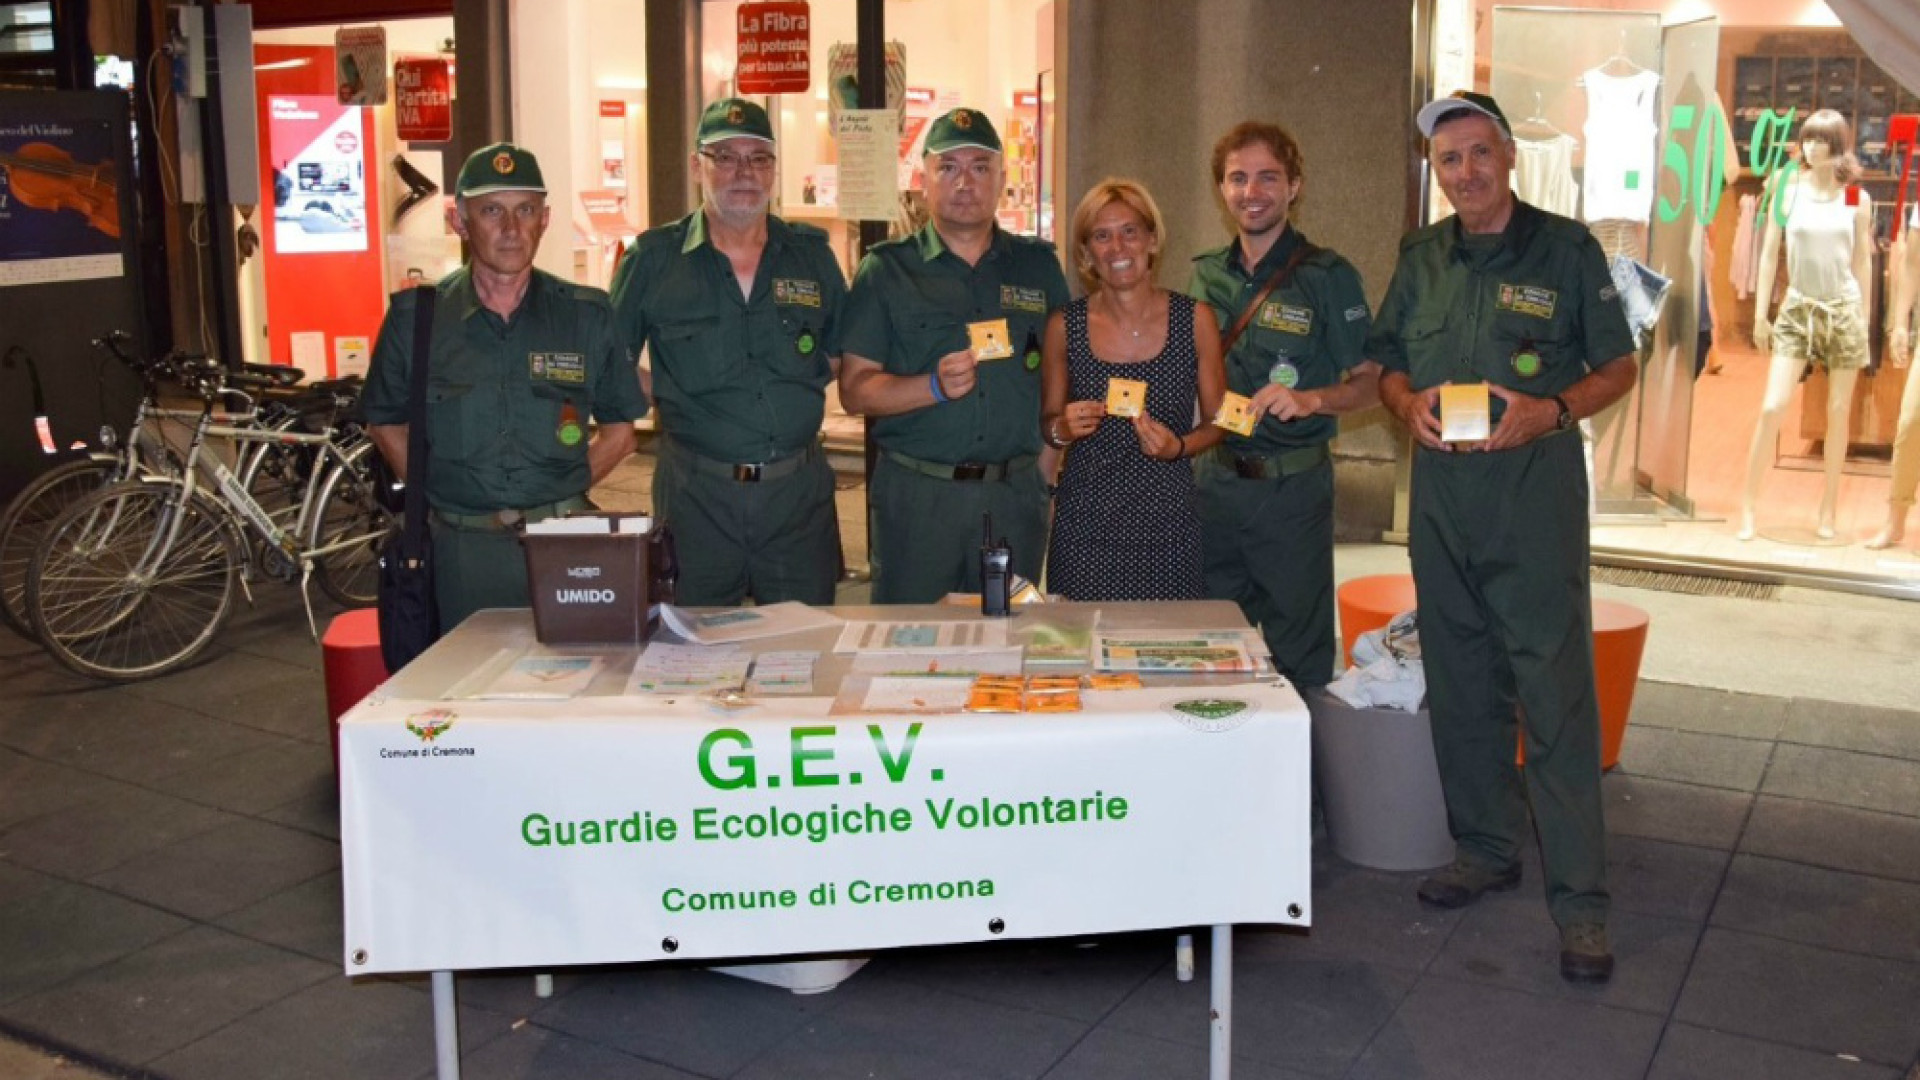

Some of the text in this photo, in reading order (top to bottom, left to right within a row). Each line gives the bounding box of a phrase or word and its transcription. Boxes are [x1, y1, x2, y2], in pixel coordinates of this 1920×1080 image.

[739, 11, 807, 33] La Fibra
[739, 38, 807, 56] più potente
[397, 67, 421, 88] Qui
[398, 87, 449, 106] Partita
[399, 107, 421, 125] IVA
[556, 588, 616, 604] UMIDO
[379, 746, 475, 758] Comune di Cremona
[696, 722, 945, 790] G.E.V.
[521, 789, 1129, 847] Guardie Ecologiche Volontarie
[661, 879, 995, 912] Comune di Cremona
